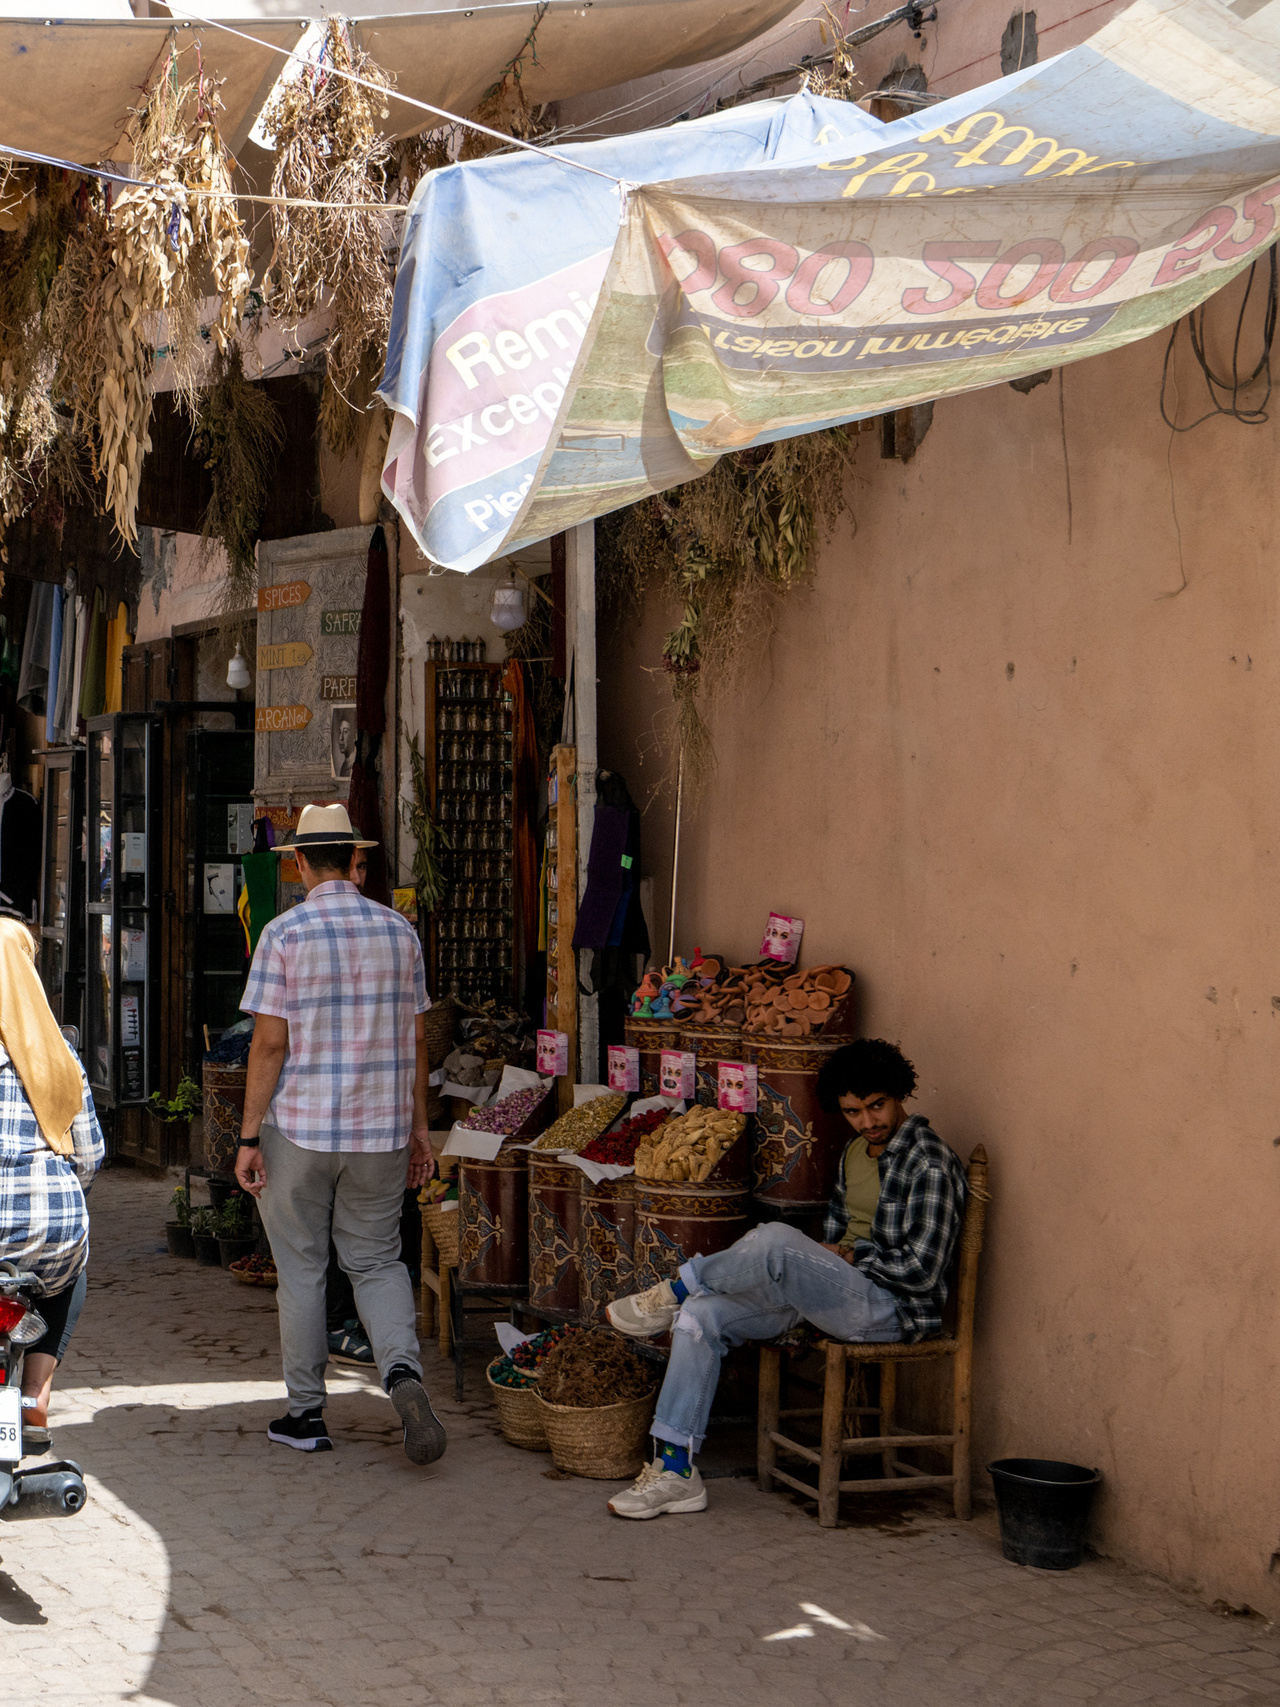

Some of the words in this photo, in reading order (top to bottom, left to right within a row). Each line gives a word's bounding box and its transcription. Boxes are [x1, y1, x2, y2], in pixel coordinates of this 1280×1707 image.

[264, 584, 302, 609] SPICES
[259, 647, 287, 666] MINT
[323, 676, 357, 701] PARF
[255, 709, 297, 729] ARGAN
